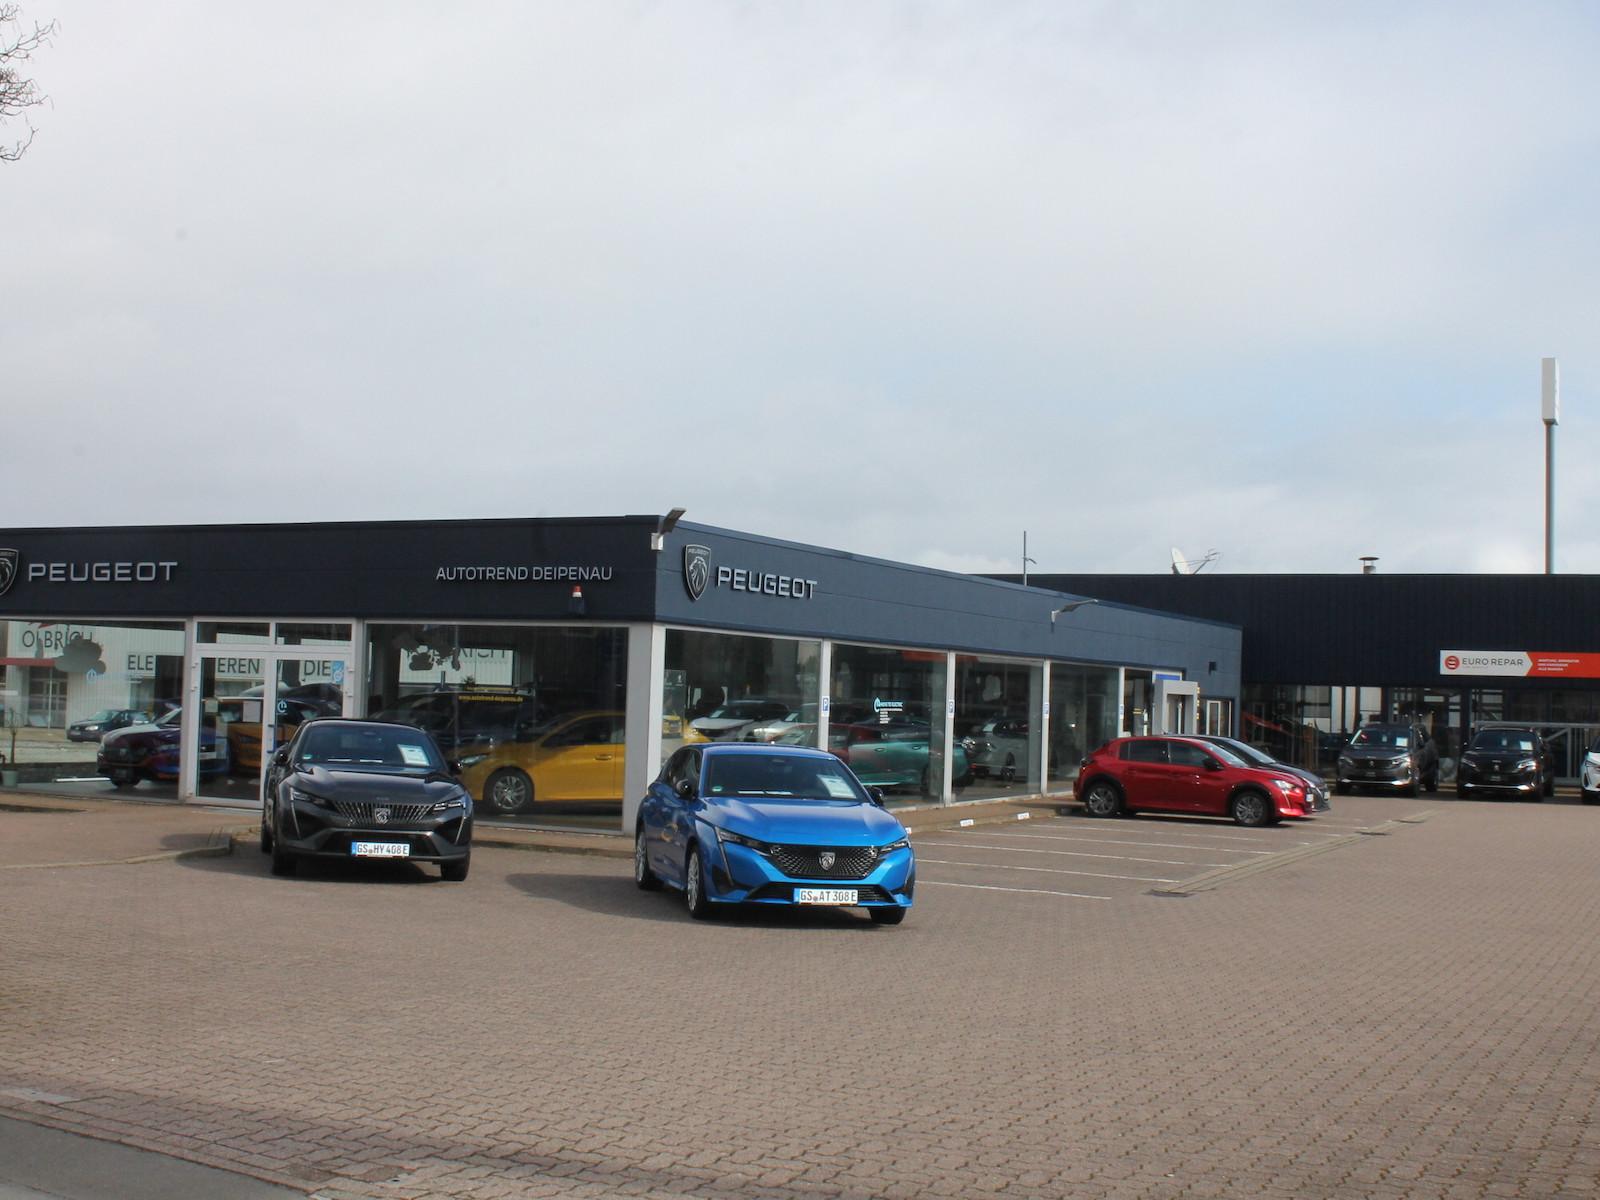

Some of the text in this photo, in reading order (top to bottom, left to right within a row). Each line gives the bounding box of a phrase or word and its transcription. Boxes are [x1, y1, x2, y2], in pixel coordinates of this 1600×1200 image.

[28, 561, 178, 582] PEUGEOT
[435, 566, 613, 581] AUTOTREND DEIPENAU
[717, 566, 818, 599] PEUGEOT
[304, 660, 331, 676] DIE
[1462, 658, 1524, 667] EURO REPAR
[357, 843, 368, 853] GS
[374, 843, 385, 854] HY
[800, 890, 813, 901] GS
[819, 891, 831, 902] AT
